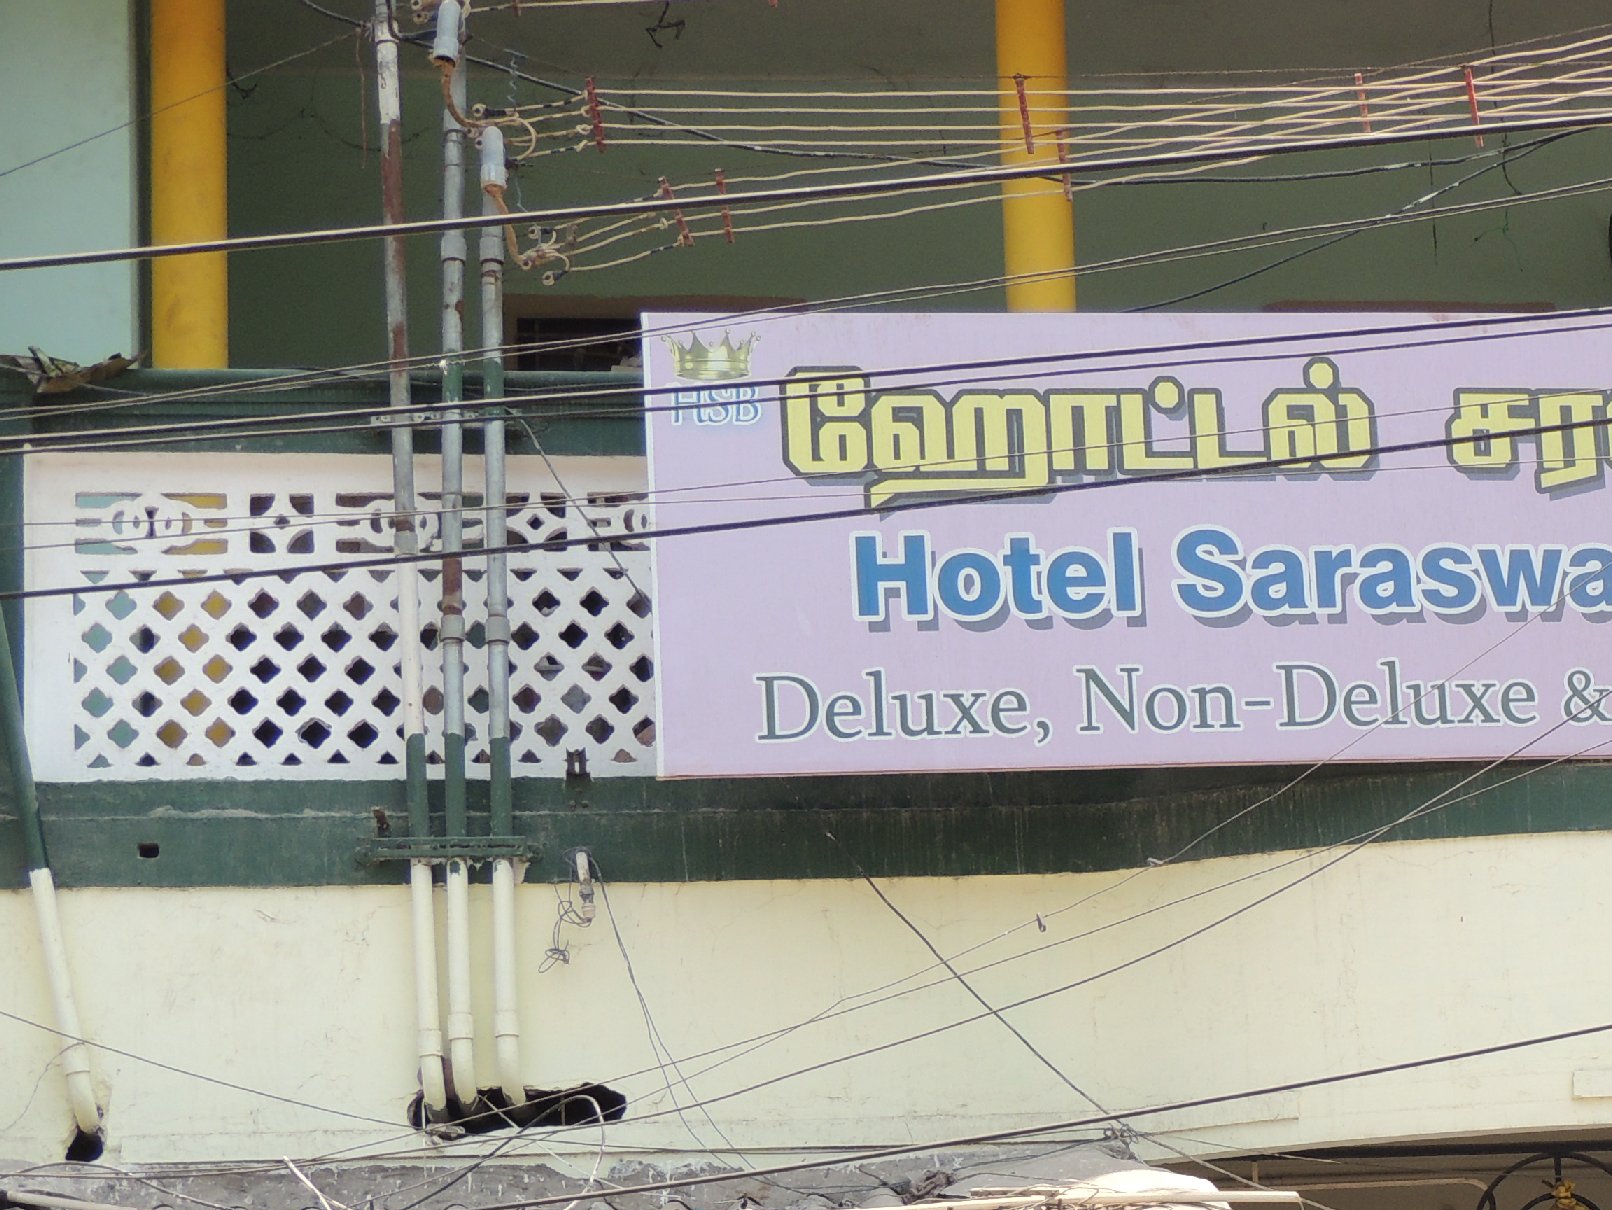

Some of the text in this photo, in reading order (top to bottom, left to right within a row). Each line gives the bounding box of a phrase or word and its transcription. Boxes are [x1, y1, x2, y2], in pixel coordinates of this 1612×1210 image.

[781, 356, 1380, 517] ஹோட்டல்
[851, 526, 1143, 628] Hotel
[753, 668, 1051, 745] Deluxe,
[1076, 660, 1536, 737] Non-Deluxe
[1563, 668, 1612, 728] &
